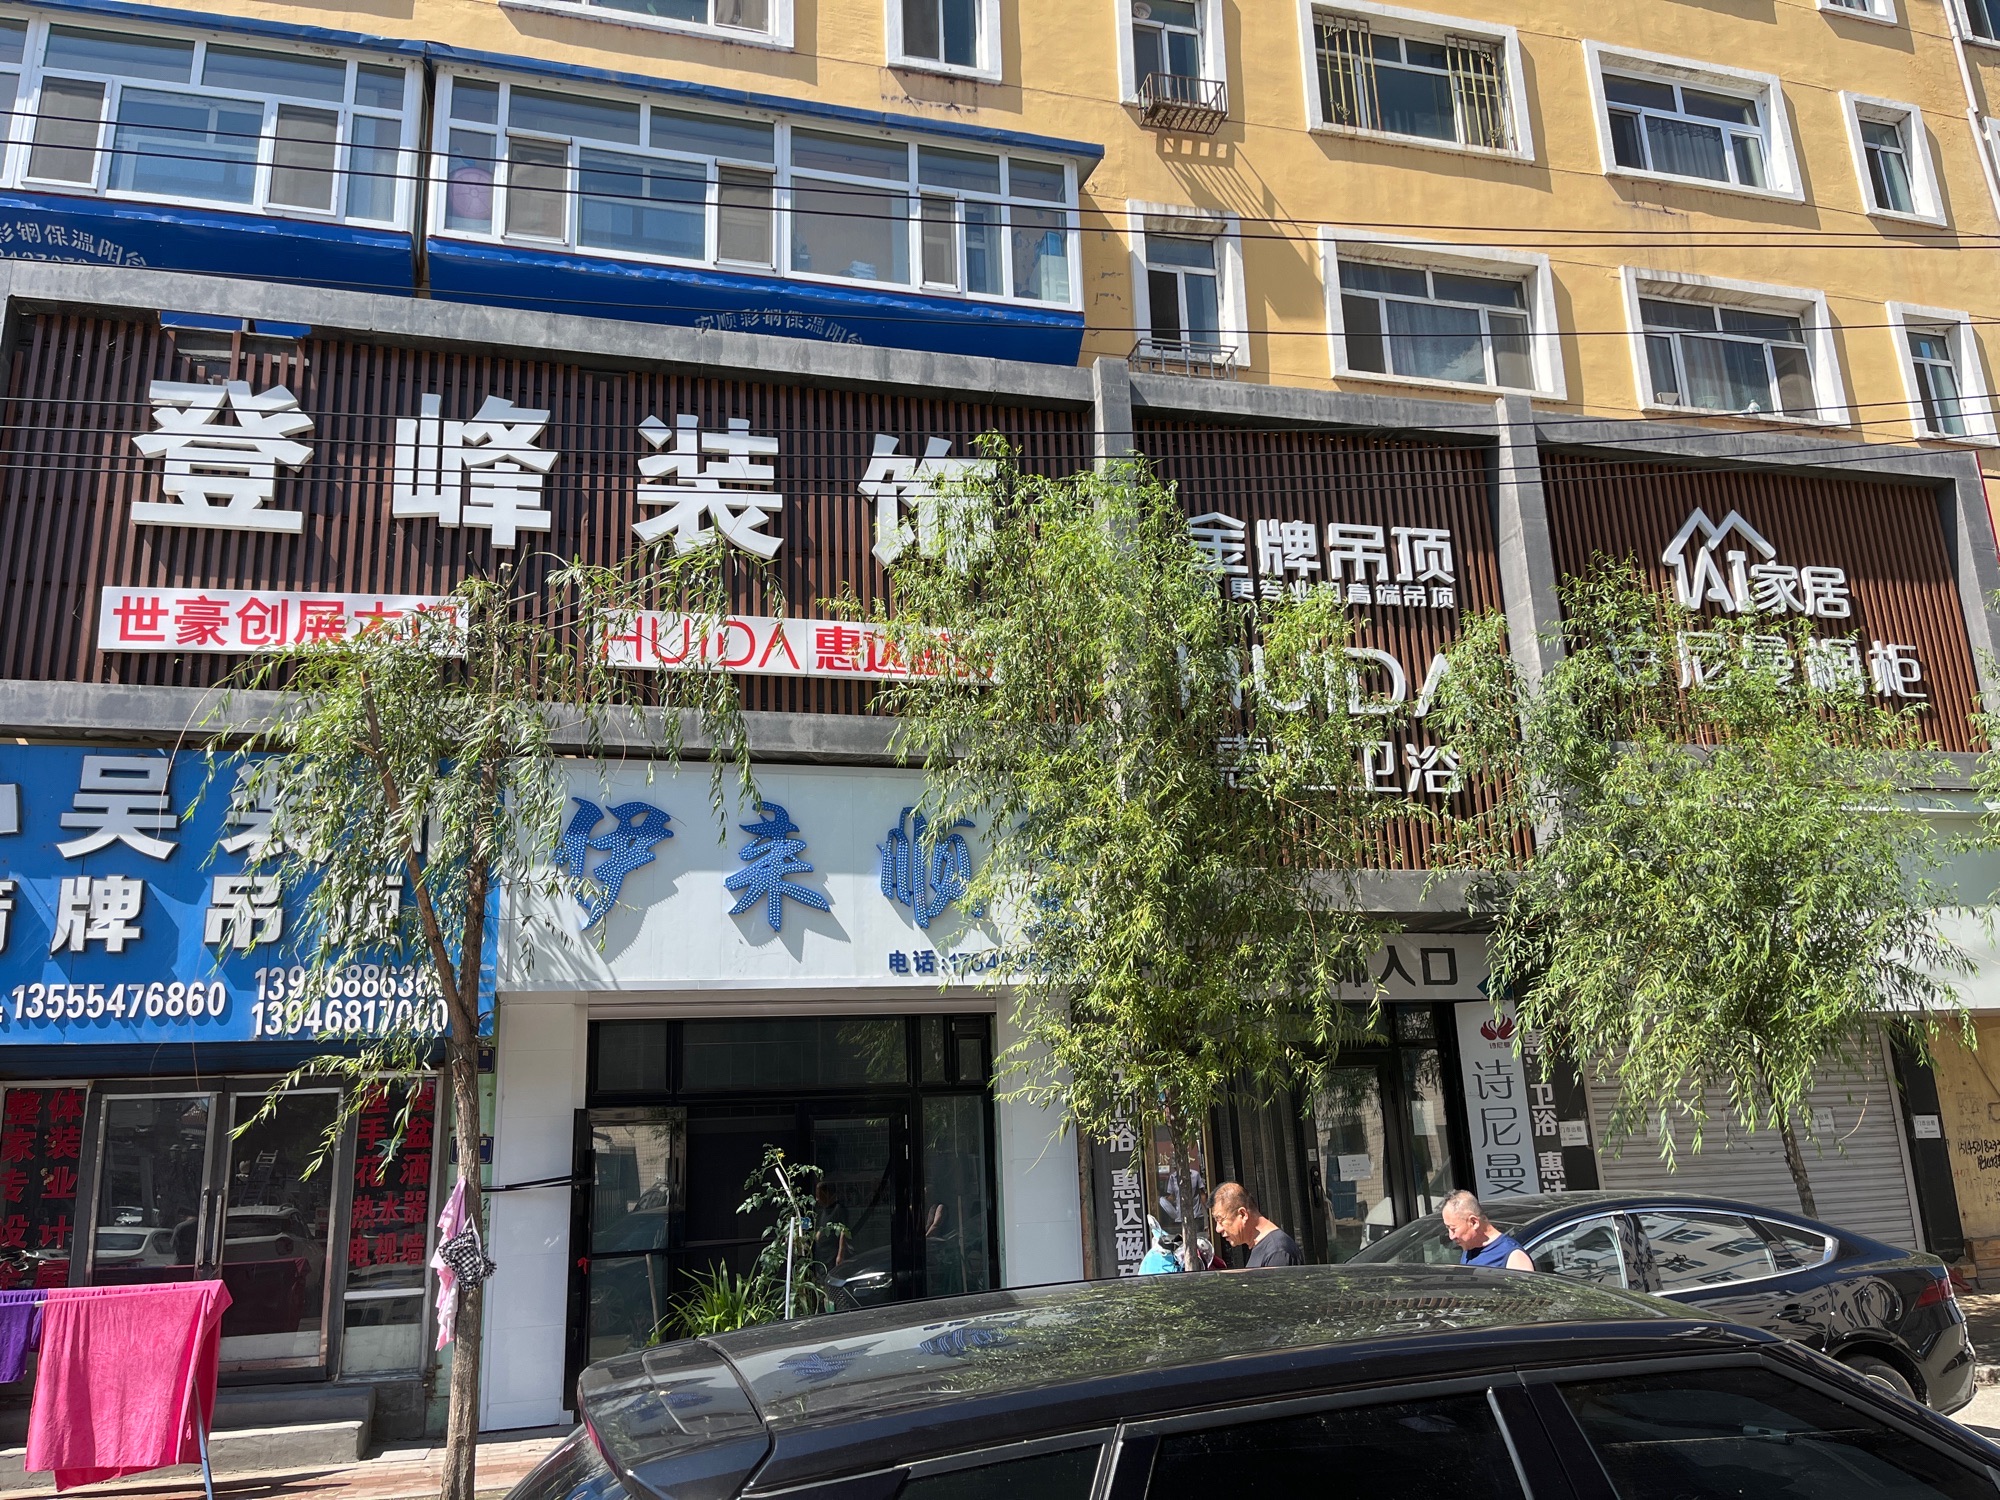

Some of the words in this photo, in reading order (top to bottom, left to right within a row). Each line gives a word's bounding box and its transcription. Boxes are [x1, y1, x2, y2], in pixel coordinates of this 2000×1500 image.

[1188, 511, 1456, 584] 金牌吊顶
[1215, 733, 1462, 793] 惠卫浴
[12, 981, 225, 1020] 13555476860
[5, 1089, 85, 1125] 整体
[0, 1125, 82, 1164] 家装
[357, 1115, 434, 1150] 手盆
[1472, 1059, 1529, 1195] 诗尼曼
[0, 1165, 78, 1203] 专业
[354, 1153, 432, 1188] 花洒
[352, 1191, 427, 1230] 热水器
[0, 1214, 73, 1250] 设计
[350, 1232, 425, 1268] 电视墙
